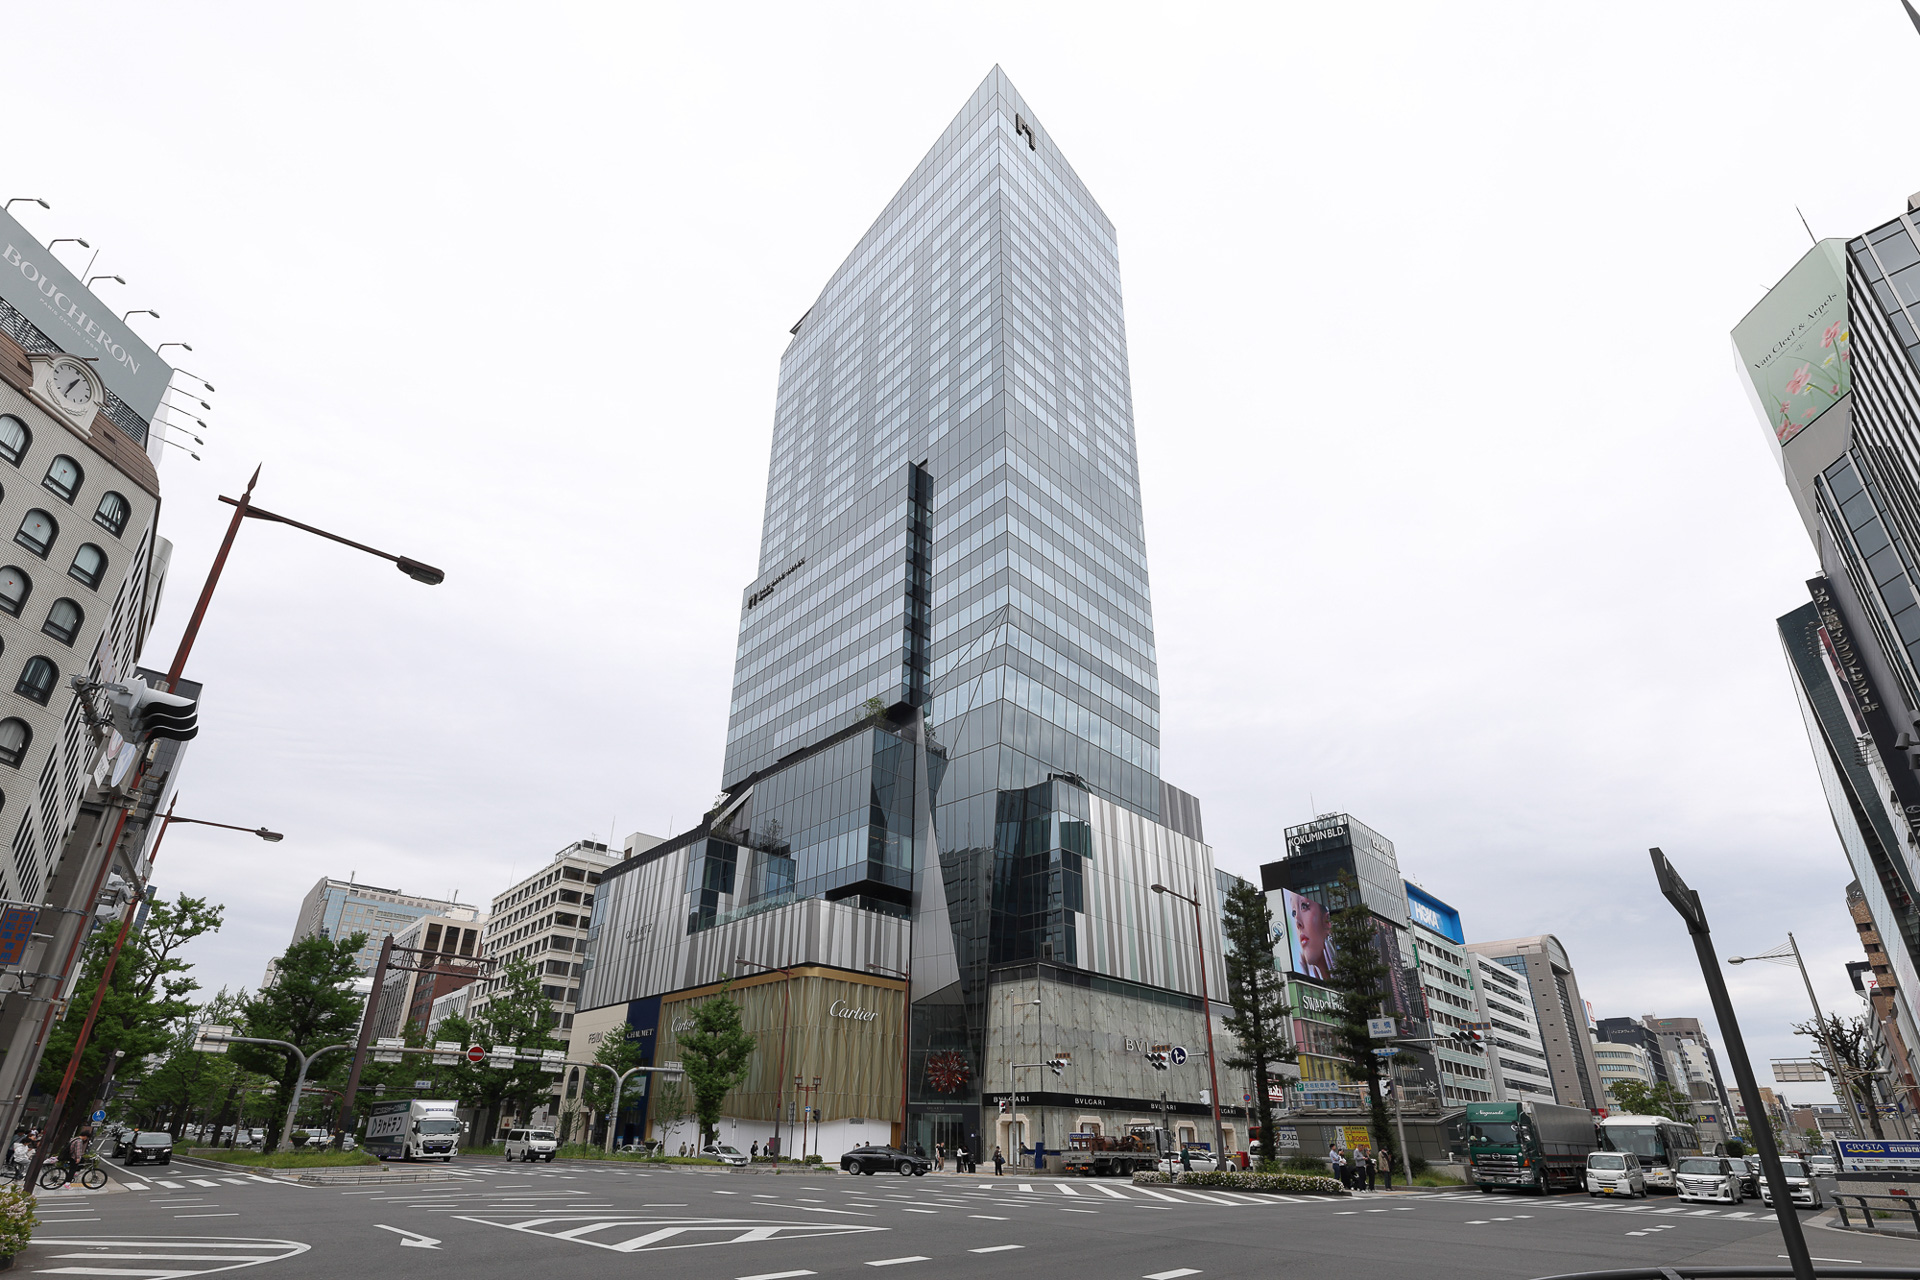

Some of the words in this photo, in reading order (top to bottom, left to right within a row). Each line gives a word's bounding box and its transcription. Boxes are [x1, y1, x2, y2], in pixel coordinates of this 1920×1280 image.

[2, 243, 140, 375] BOUCHERON
[39, 298, 58, 316] PARIS
[59, 315, 82, 337] DEPUIS
[1754, 354, 1772, 369] Van
[1772, 327, 1796, 354] Cleef
[1798, 323, 1805, 331] &
[1807, 293, 1837, 322] Arpels
[1288, 830, 1327, 848] KOKUMIN
[1327, 826, 1346, 838] BLD.
[1414, 901, 1440, 930] HOKA
[829, 1000, 878, 1021] Cartier
[1074, 1098, 1106, 1106] BVLGARI
